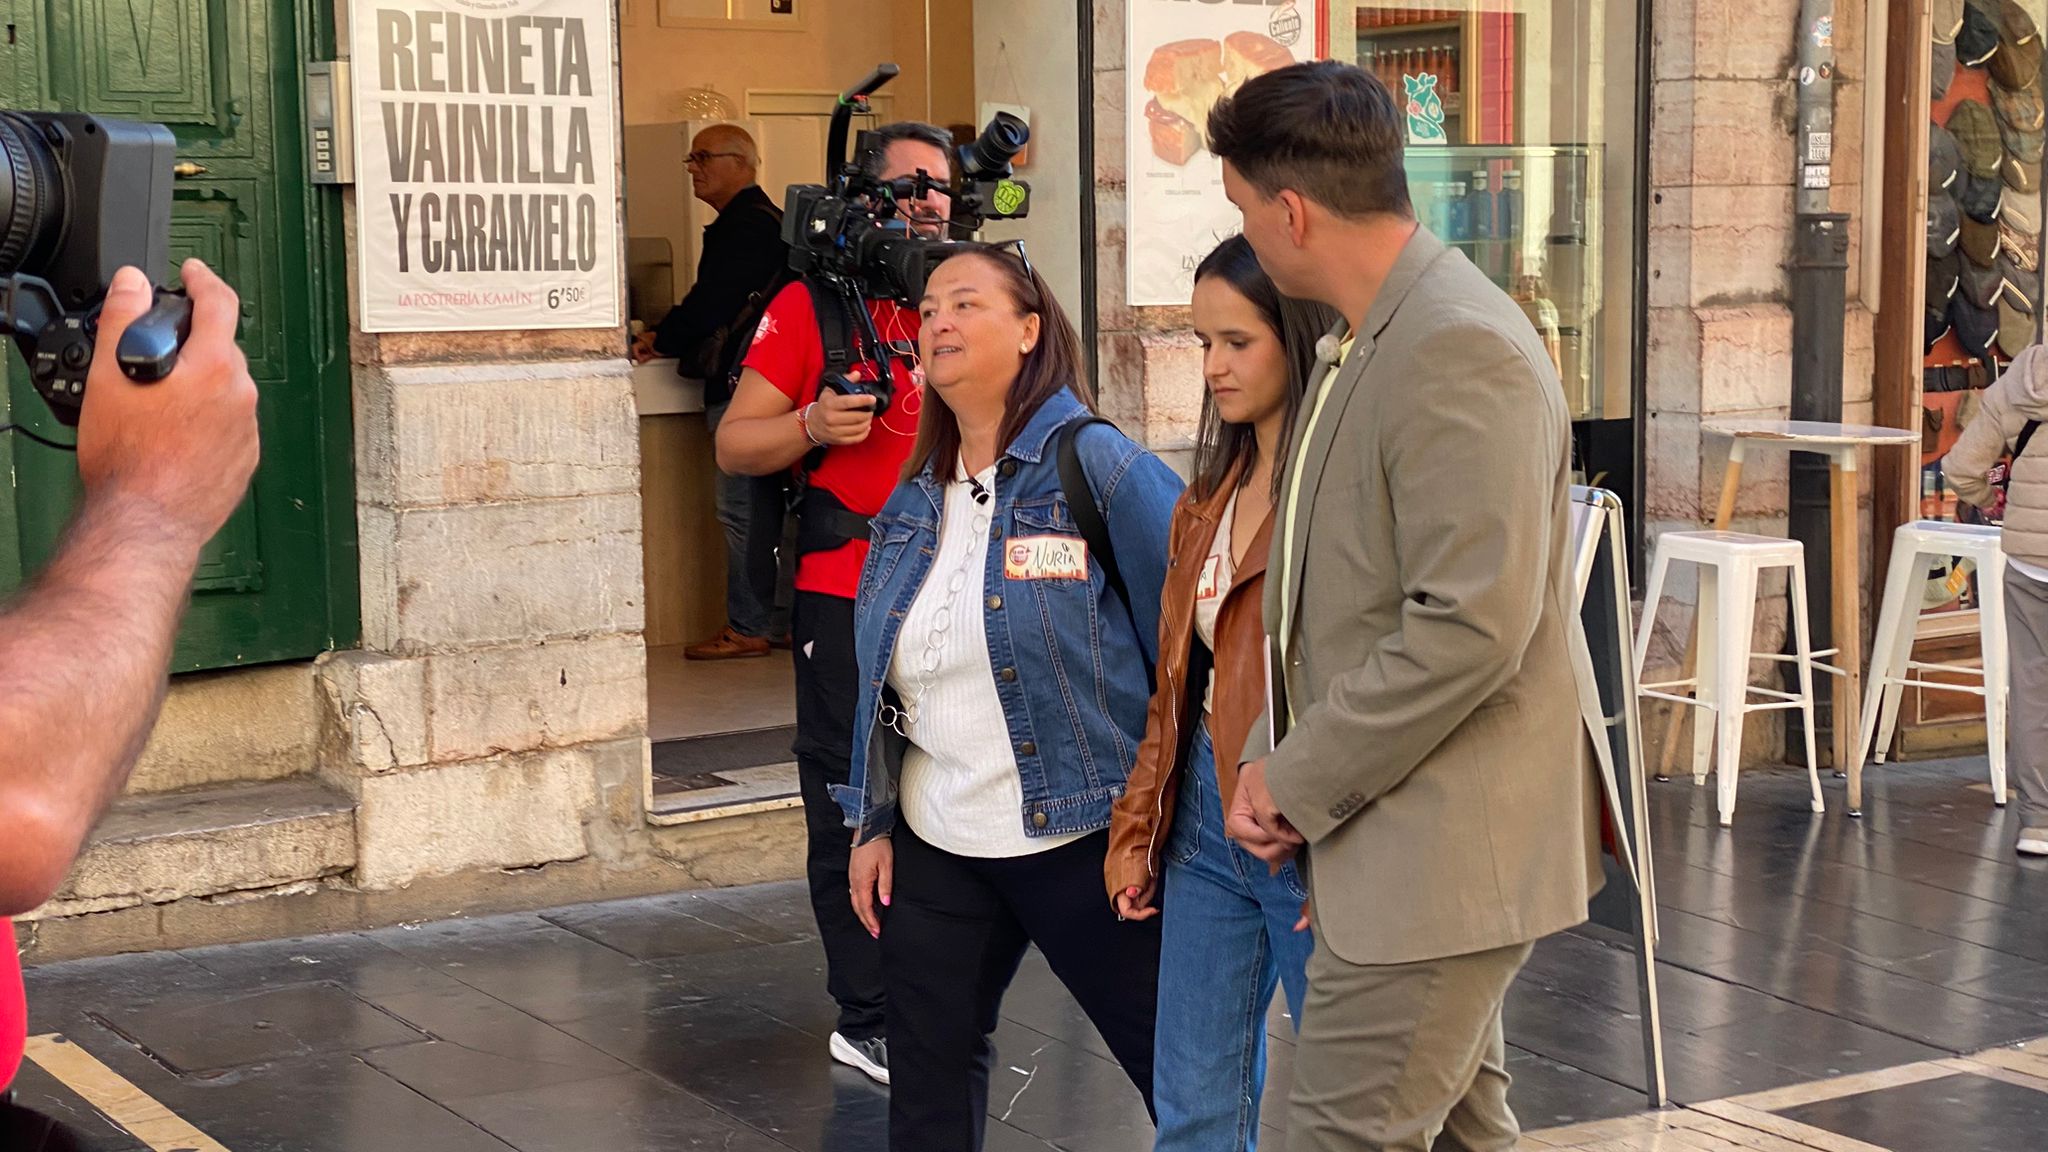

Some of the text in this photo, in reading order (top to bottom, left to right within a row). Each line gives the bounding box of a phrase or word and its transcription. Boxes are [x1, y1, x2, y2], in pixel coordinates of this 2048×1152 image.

[376, 8, 593, 97] REINETA
[381, 101, 596, 185] VAINILLA
[389, 192, 597, 274] Y CARAMELO
[398, 294, 413, 307] LA
